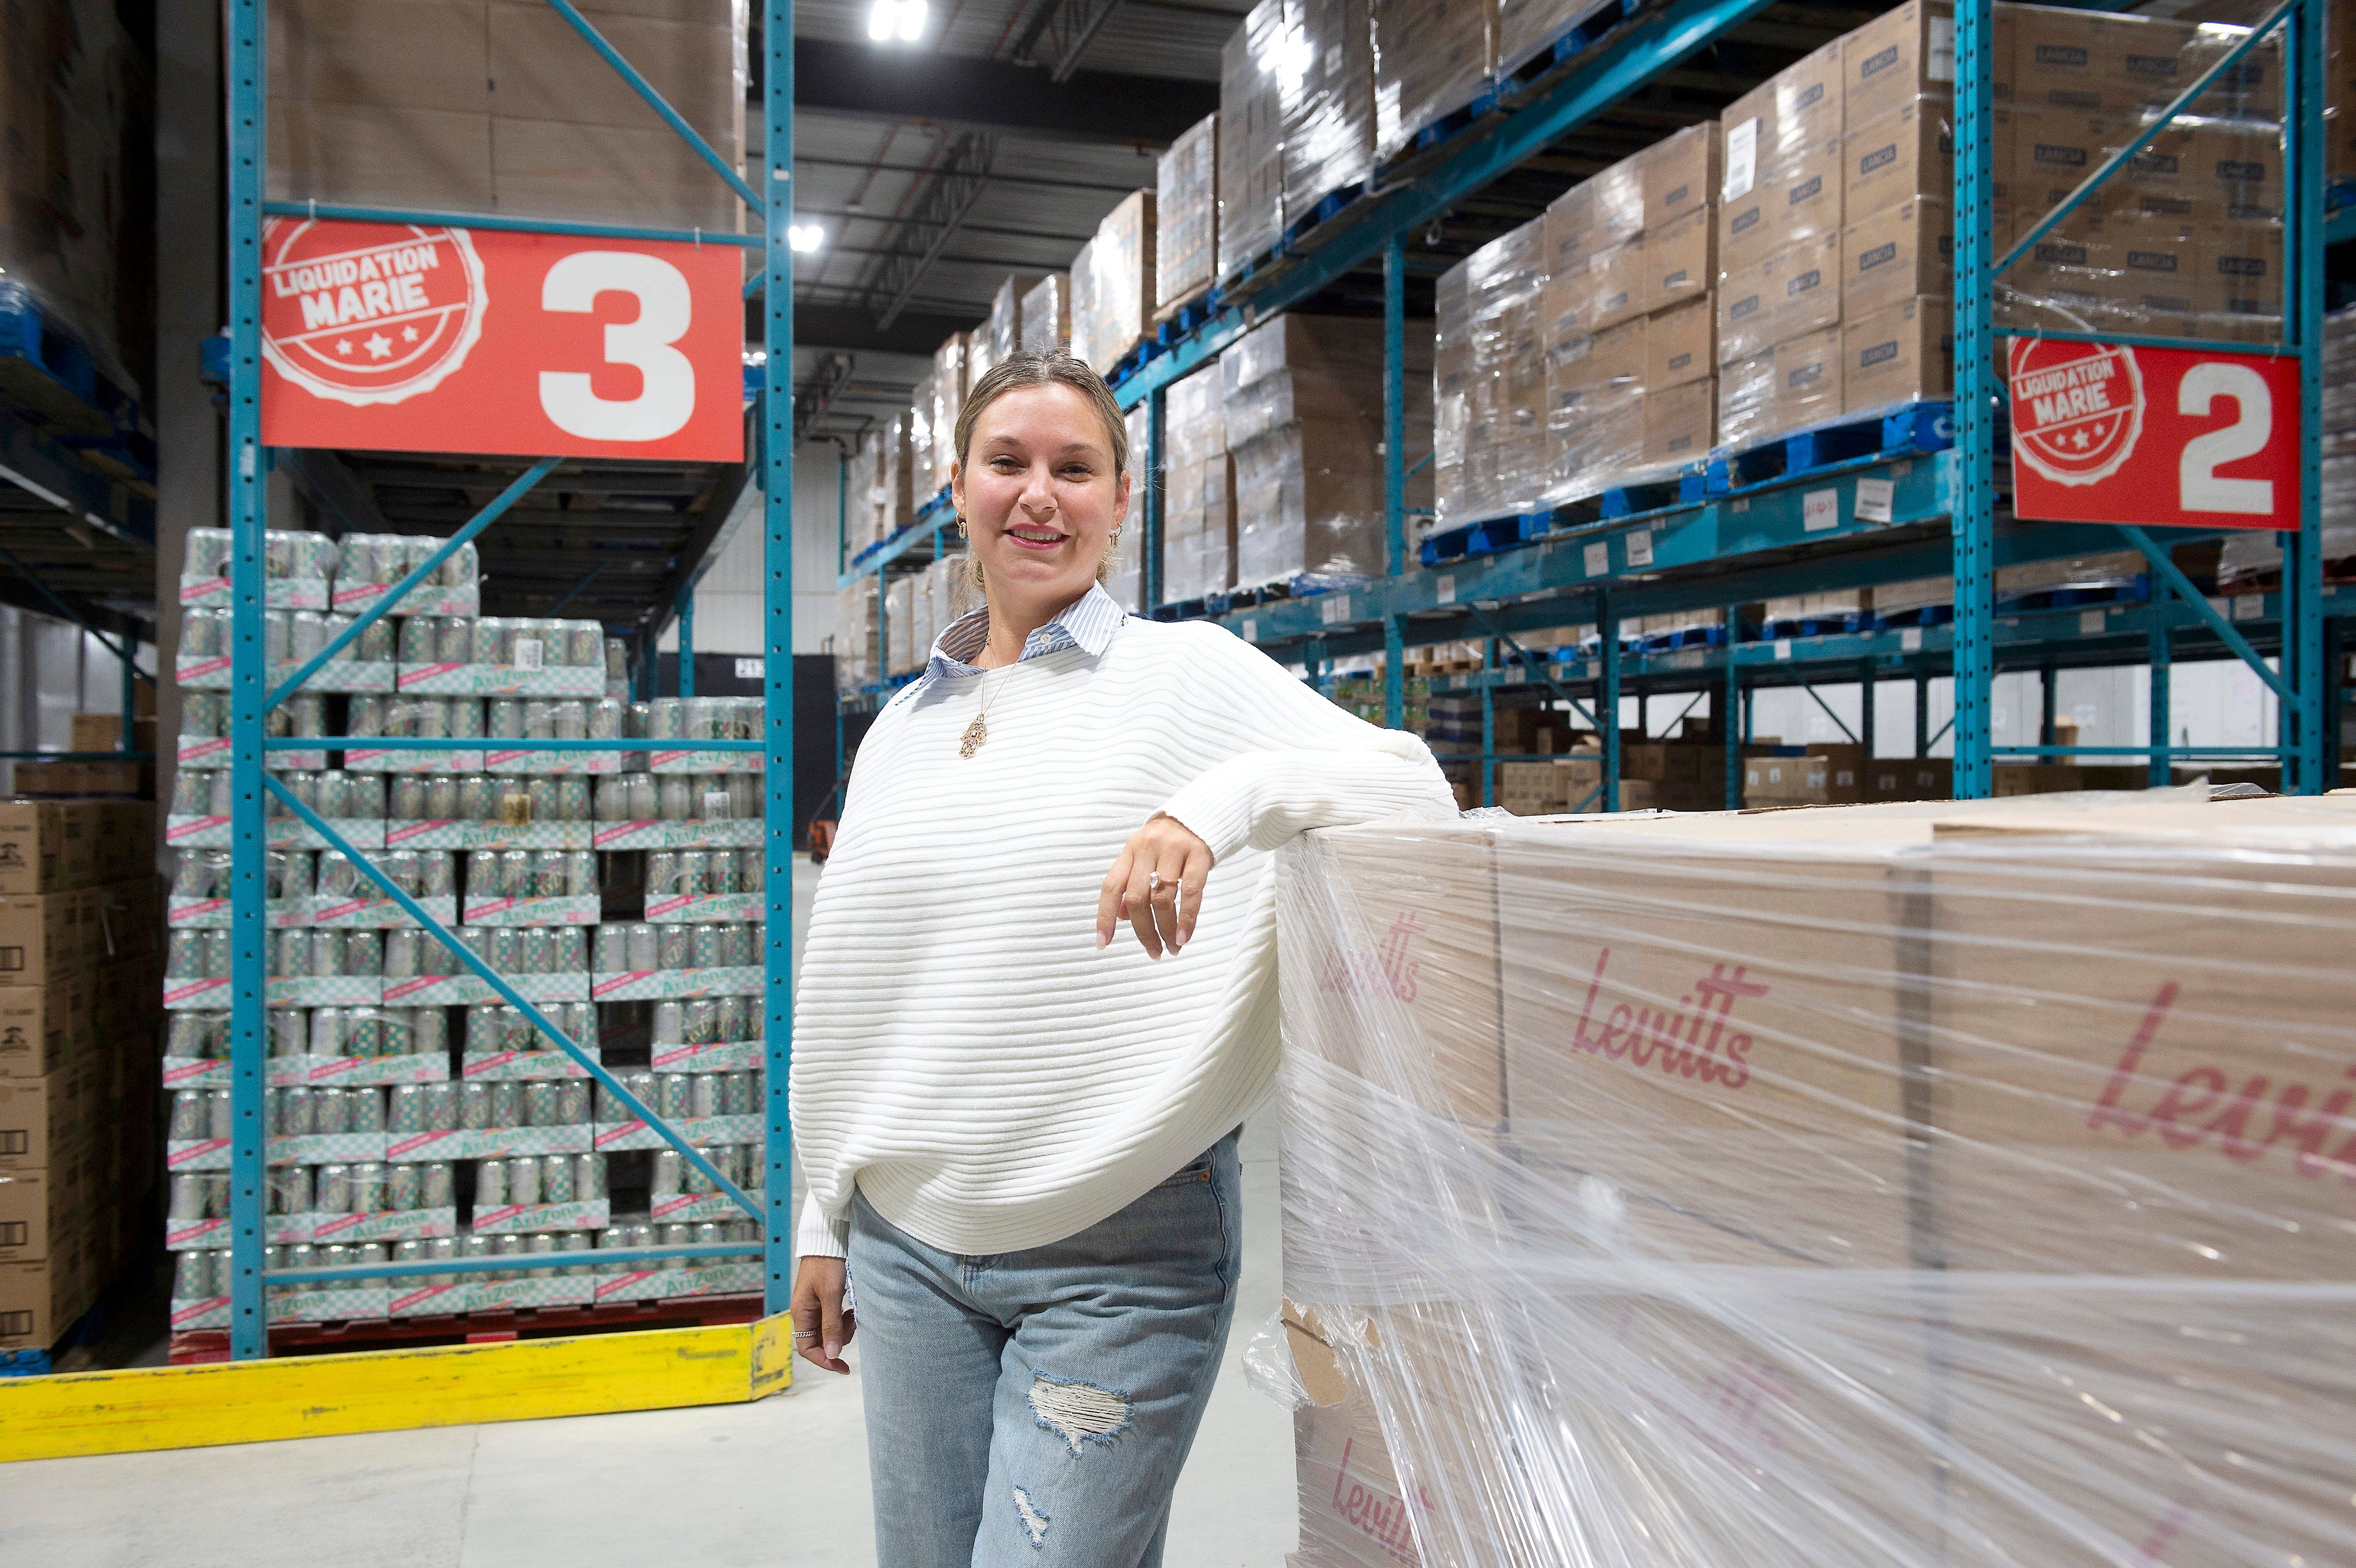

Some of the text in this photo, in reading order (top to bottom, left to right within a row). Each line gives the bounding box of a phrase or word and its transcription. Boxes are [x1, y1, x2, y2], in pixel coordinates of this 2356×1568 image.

[272, 243, 439, 298] LIQUIDATION
[299, 272, 430, 330] MARIE
[538, 250, 695, 441] 3
[2017, 359, 2115, 401] LIQUIDATION
[2033, 381, 2110, 426] MARIE
[2178, 362, 2274, 515] 2
[1571, 947, 1770, 1089] Levitts
[512, 1203, 582, 1232] AriZona
[1332, 1437, 1436, 1567] Levitt
